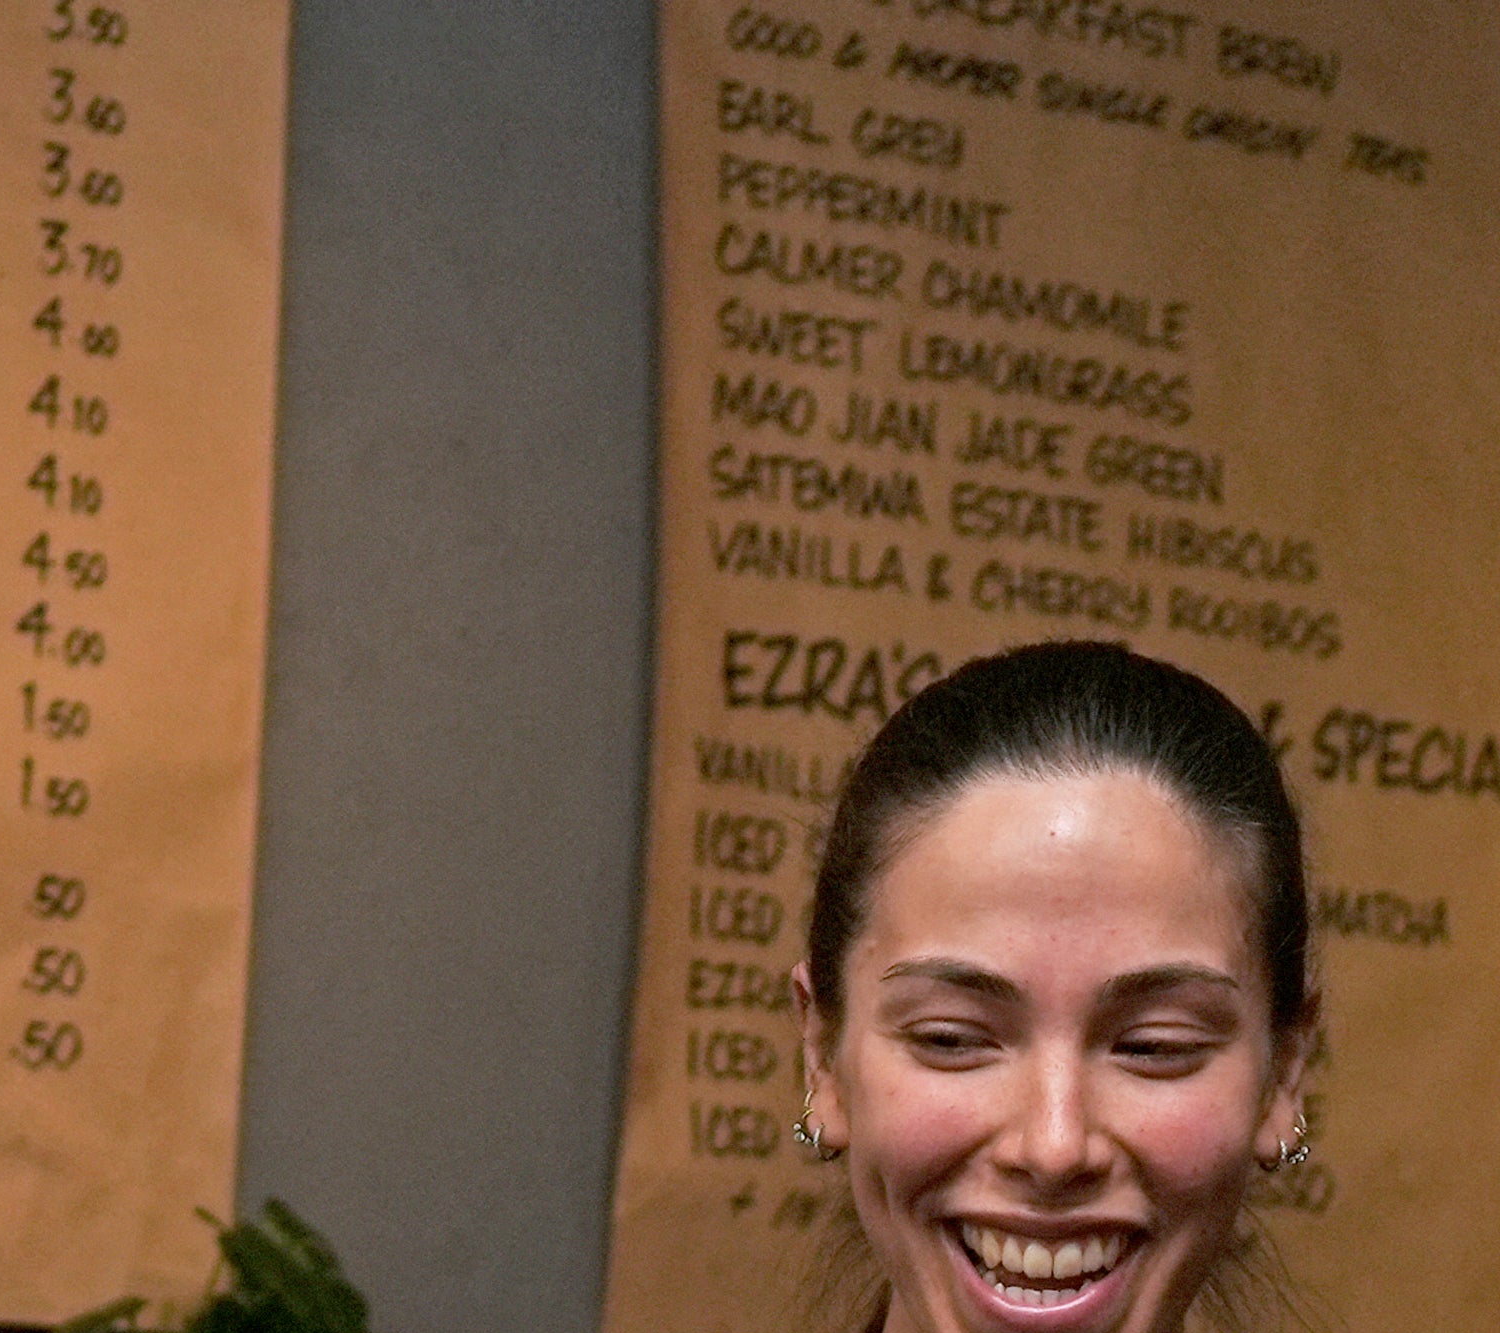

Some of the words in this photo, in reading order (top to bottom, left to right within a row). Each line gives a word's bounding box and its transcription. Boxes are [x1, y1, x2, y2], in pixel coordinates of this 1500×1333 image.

[716, 79, 830, 147] EARL
[850, 105, 966, 170] GREY
[717, 153, 1011, 249] PEPPERMINT
[714, 221, 904, 300] CALMER
[921, 260, 1191, 353] CHAMOMILE
[714, 298, 877, 375] SWEET
[900, 331, 1194, 428] LEMONGRASS
[710, 373, 817, 437] MAO
[829, 391, 937, 456] JIAN
[952, 407, 1074, 479] JADE
[1085, 435, 1224, 504] GREEN
[707, 519, 908, 594] VANILLA
[970, 557, 1150, 630] CHERRY
[948, 481, 1104, 553] ESTATE
[1126, 512, 1320, 586] HIBISCUS
